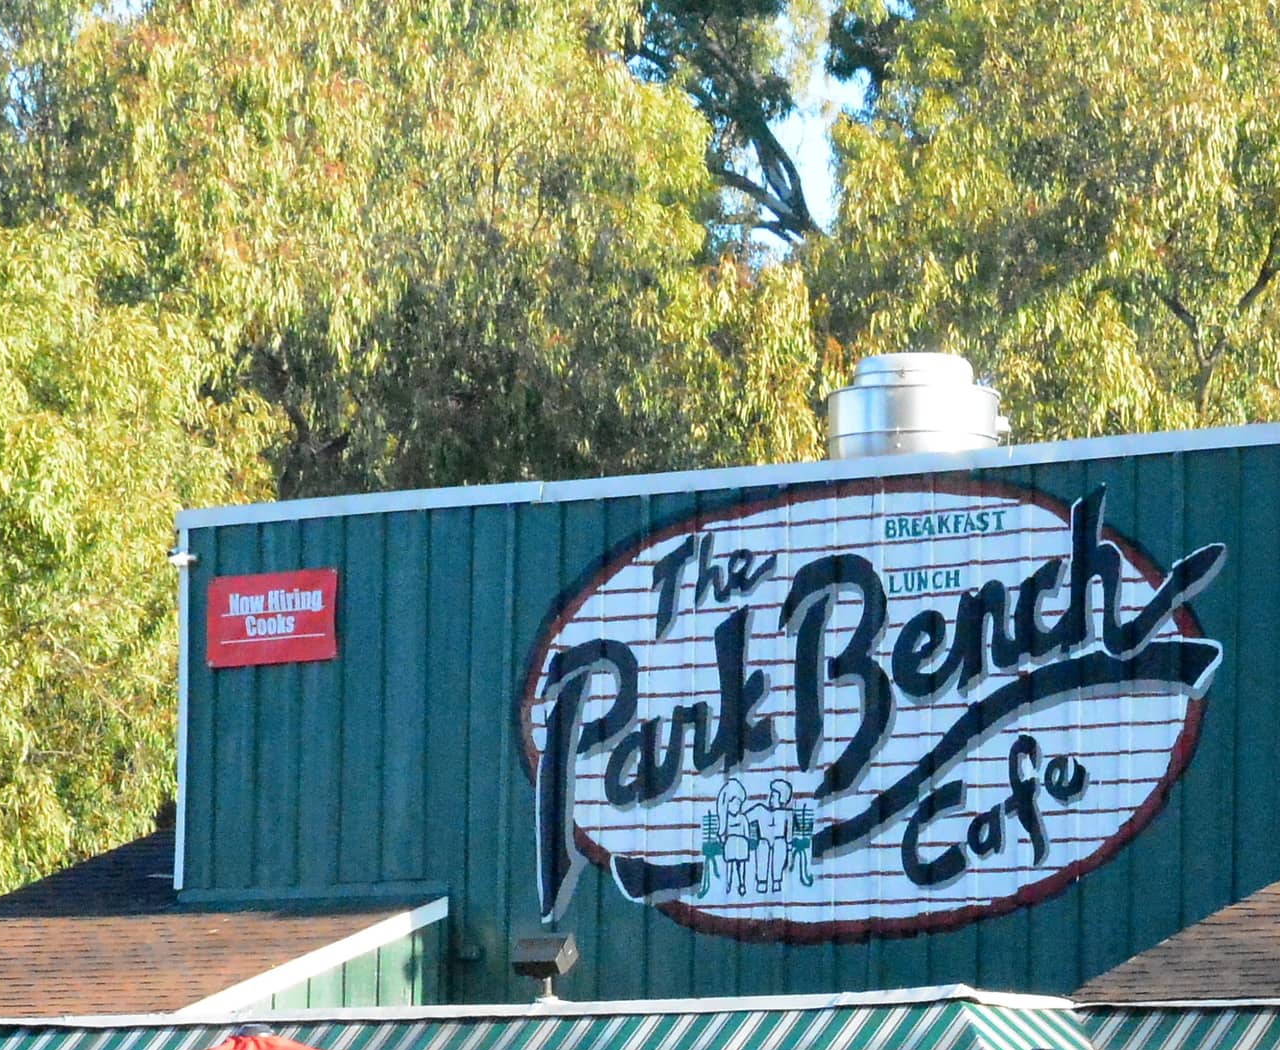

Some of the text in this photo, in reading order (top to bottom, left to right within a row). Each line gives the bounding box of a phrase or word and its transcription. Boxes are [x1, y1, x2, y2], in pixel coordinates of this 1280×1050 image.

[885, 510, 1006, 538] BREAKFAST
[652, 532, 778, 640] The
[888, 569, 960, 594] LUNCH
[229, 588, 322, 616] Now Hiring
[245, 613, 295, 636] Cooks
[536, 482, 1227, 922] Park Bench
[901, 734, 1088, 888] Cafe
